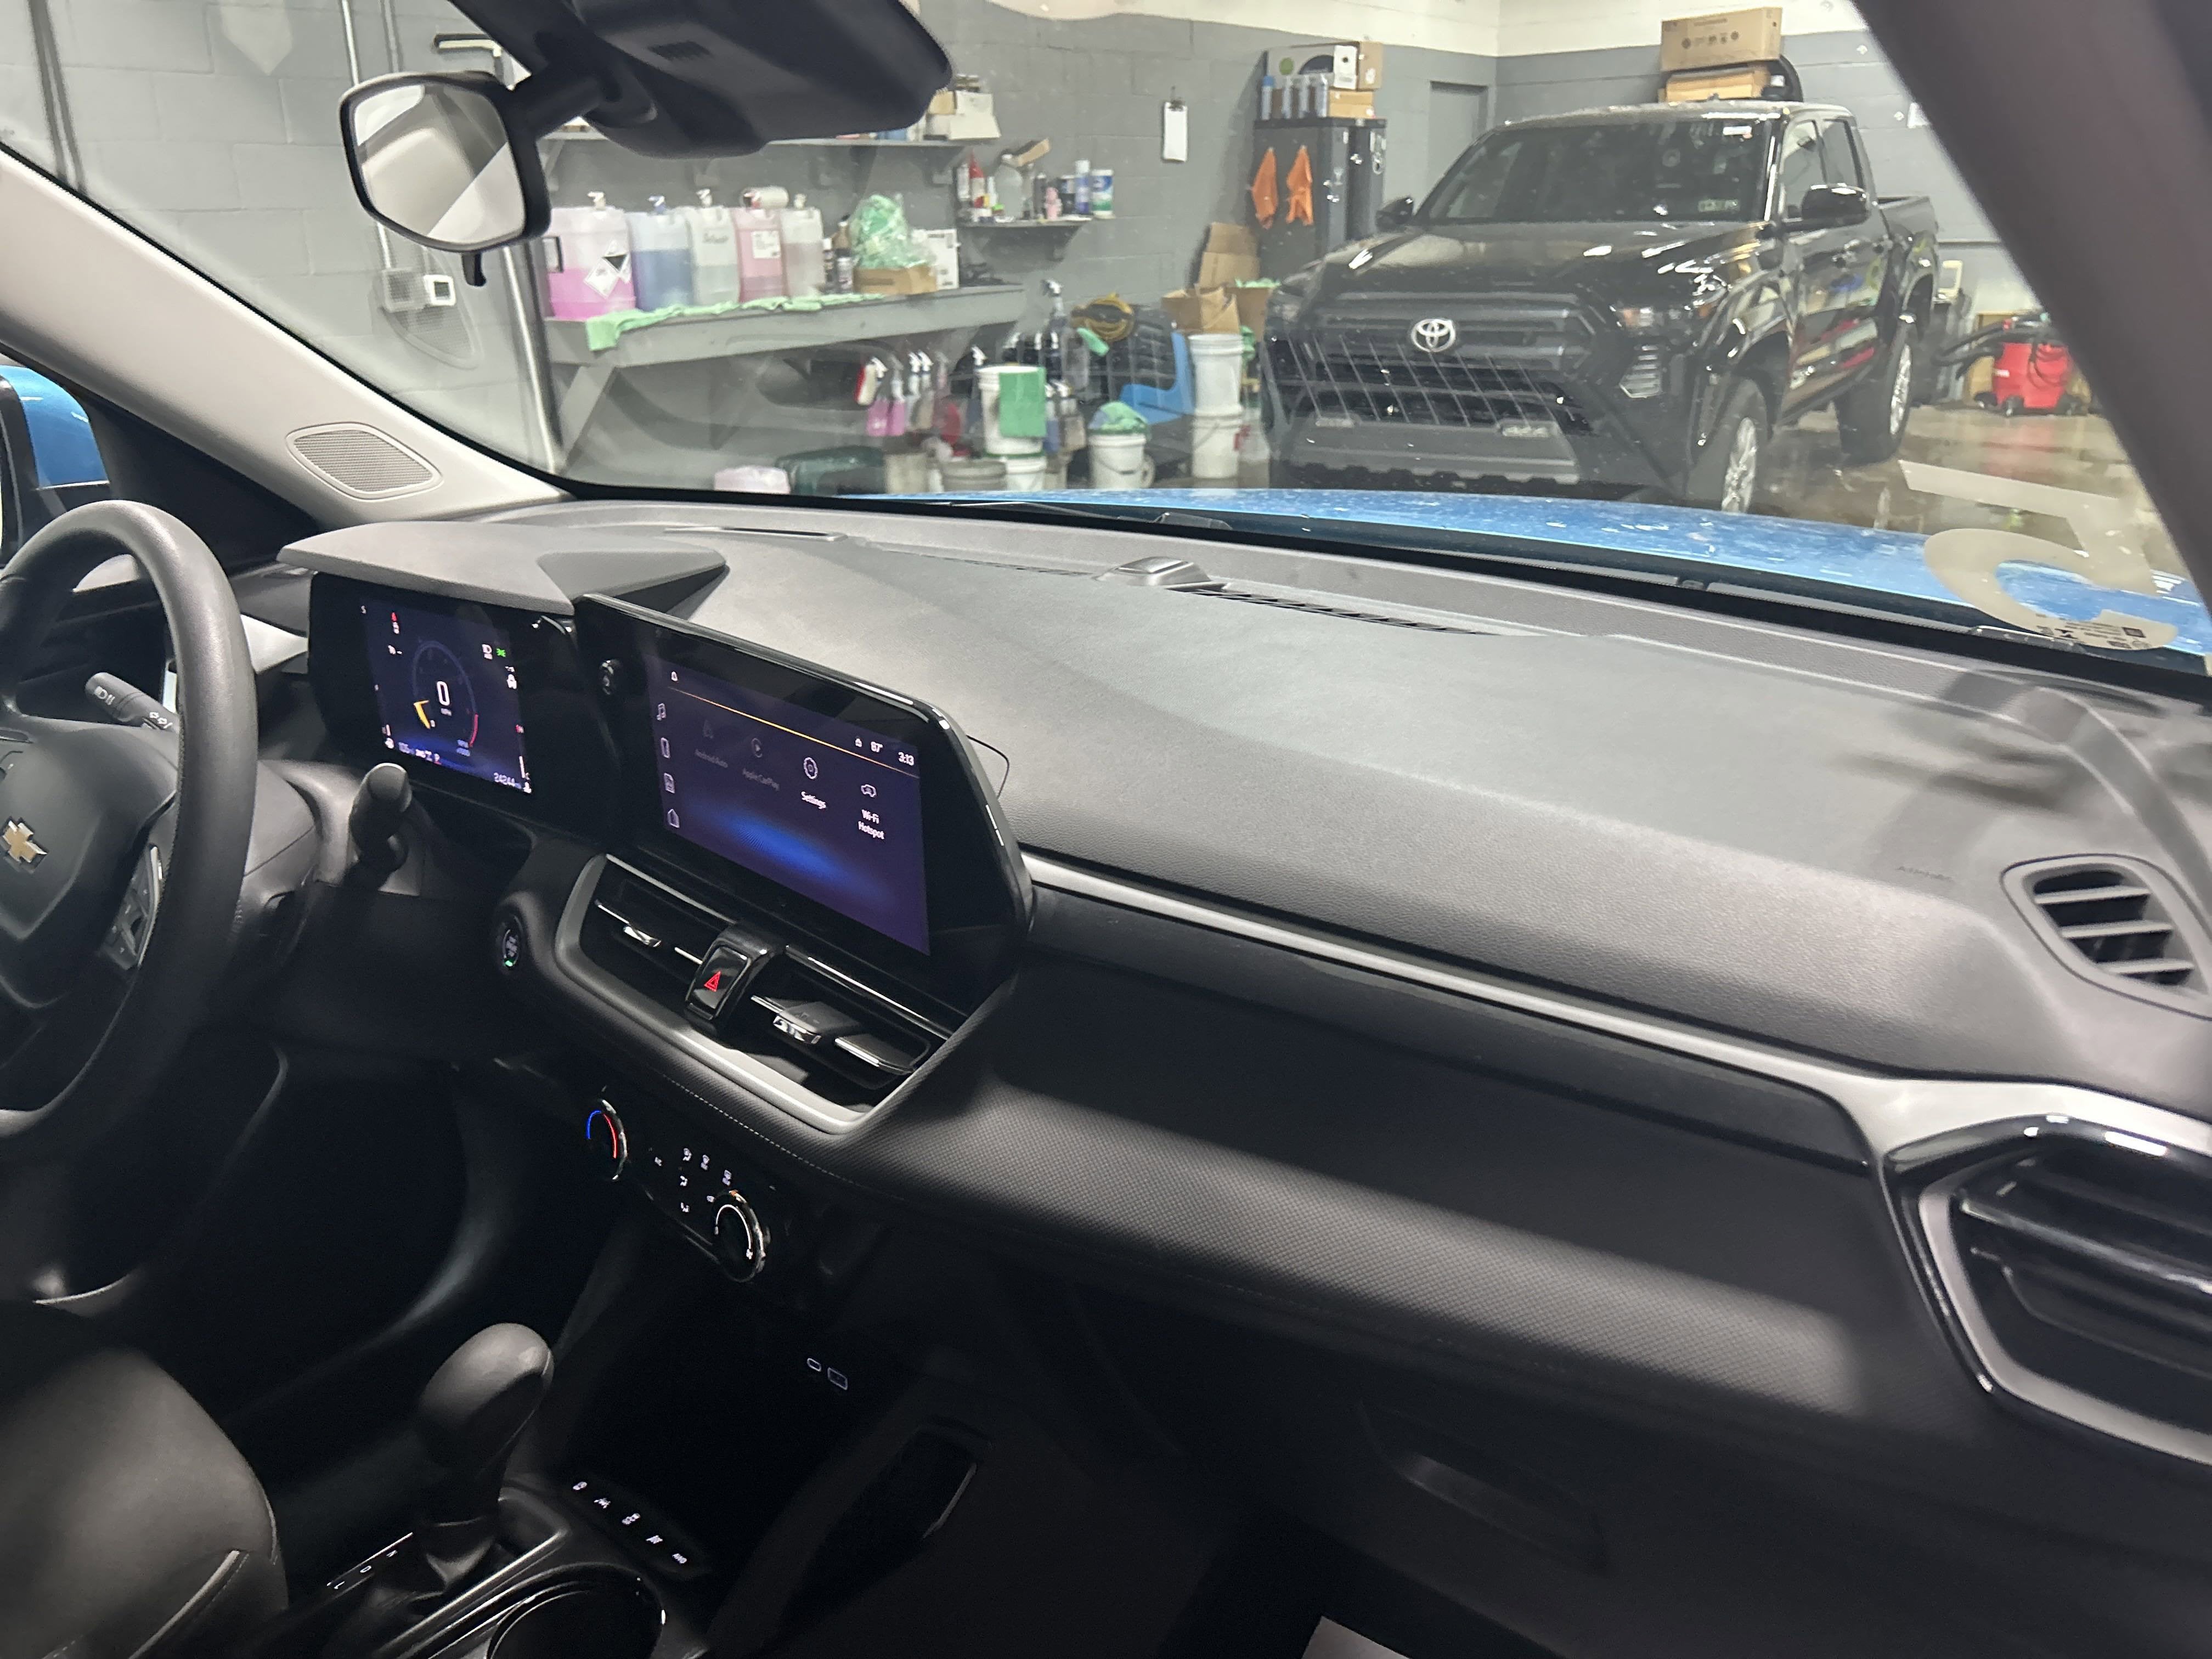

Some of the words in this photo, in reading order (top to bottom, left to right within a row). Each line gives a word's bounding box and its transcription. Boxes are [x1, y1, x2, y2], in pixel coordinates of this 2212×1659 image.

[436, 681, 450, 706] 0
[898, 752, 915, 766] 3:13
[800, 791, 827, 810] Settings
[861, 809, 880, 824] Wi-Fi
[857, 821, 885, 839] Hotspot
